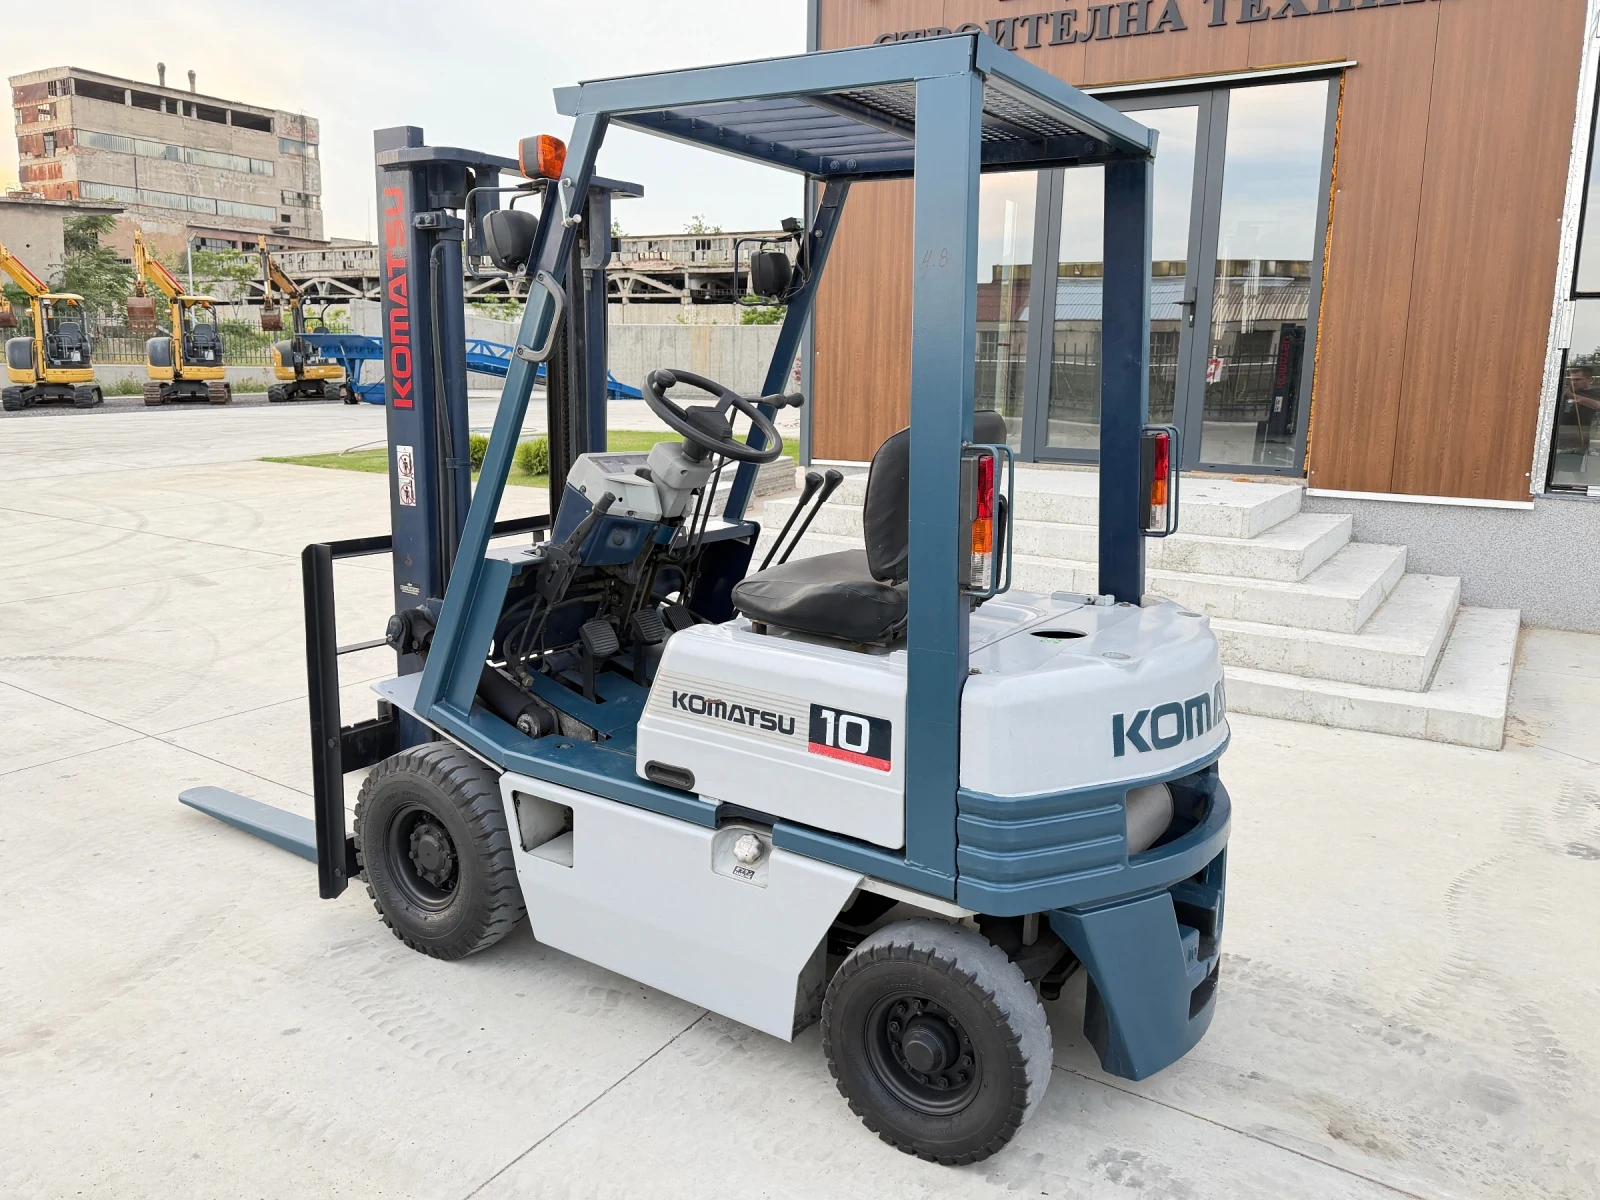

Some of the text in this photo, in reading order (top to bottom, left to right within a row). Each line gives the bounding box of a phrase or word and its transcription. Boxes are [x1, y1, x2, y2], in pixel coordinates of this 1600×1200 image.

[873, 0, 1188, 51] ИТЕЛНА
[384, 186, 413, 407] KOMATSU
[672, 690, 869, 753] KOMATSU 10
[1112, 680, 1227, 757] KOMA
